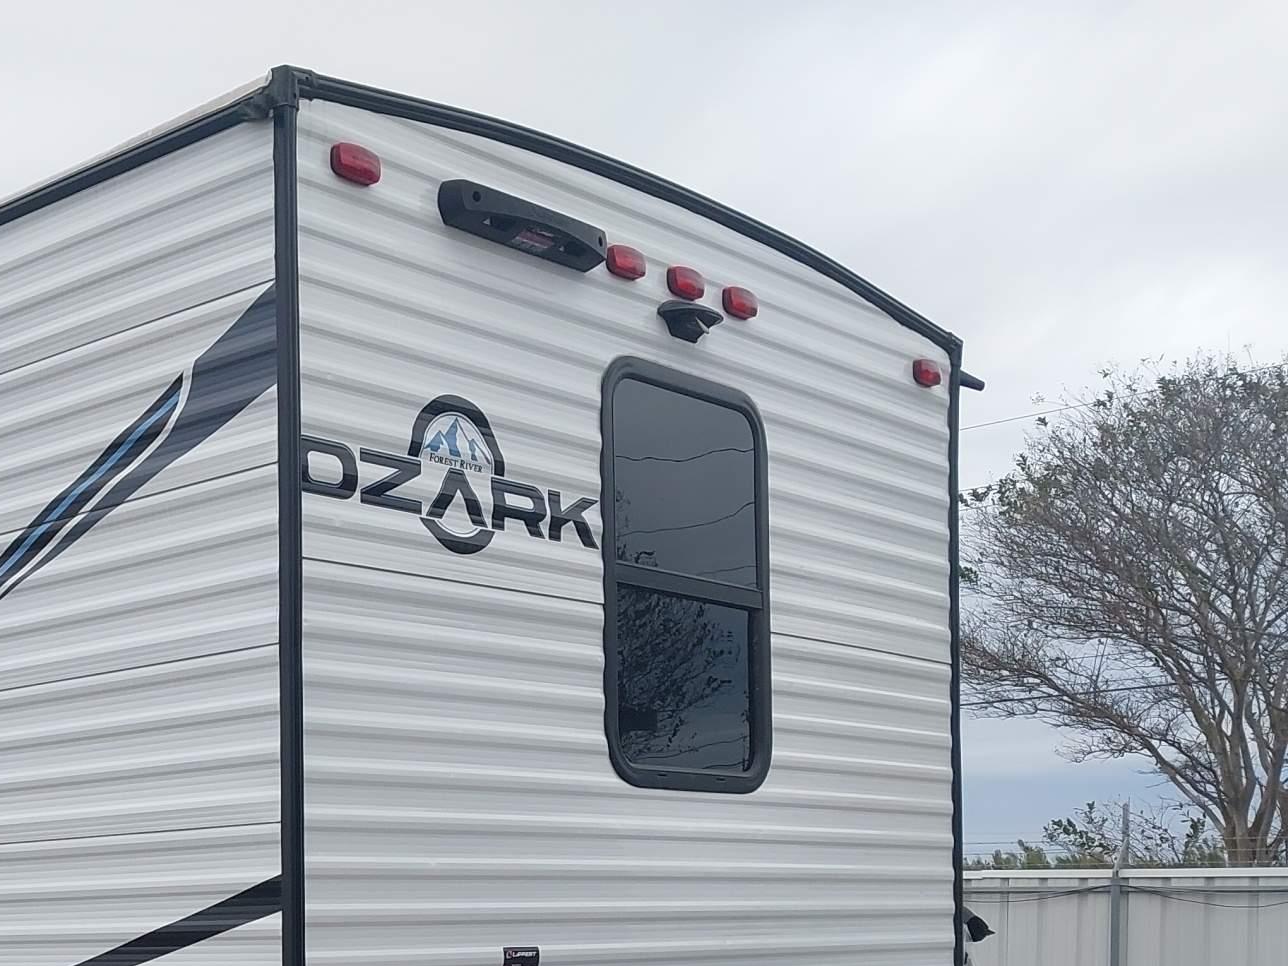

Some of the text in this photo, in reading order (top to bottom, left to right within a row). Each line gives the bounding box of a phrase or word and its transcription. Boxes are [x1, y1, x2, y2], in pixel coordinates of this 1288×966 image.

[301, 434, 600, 550] OZARK
[429, 452, 483, 473] FOREST RIVER
